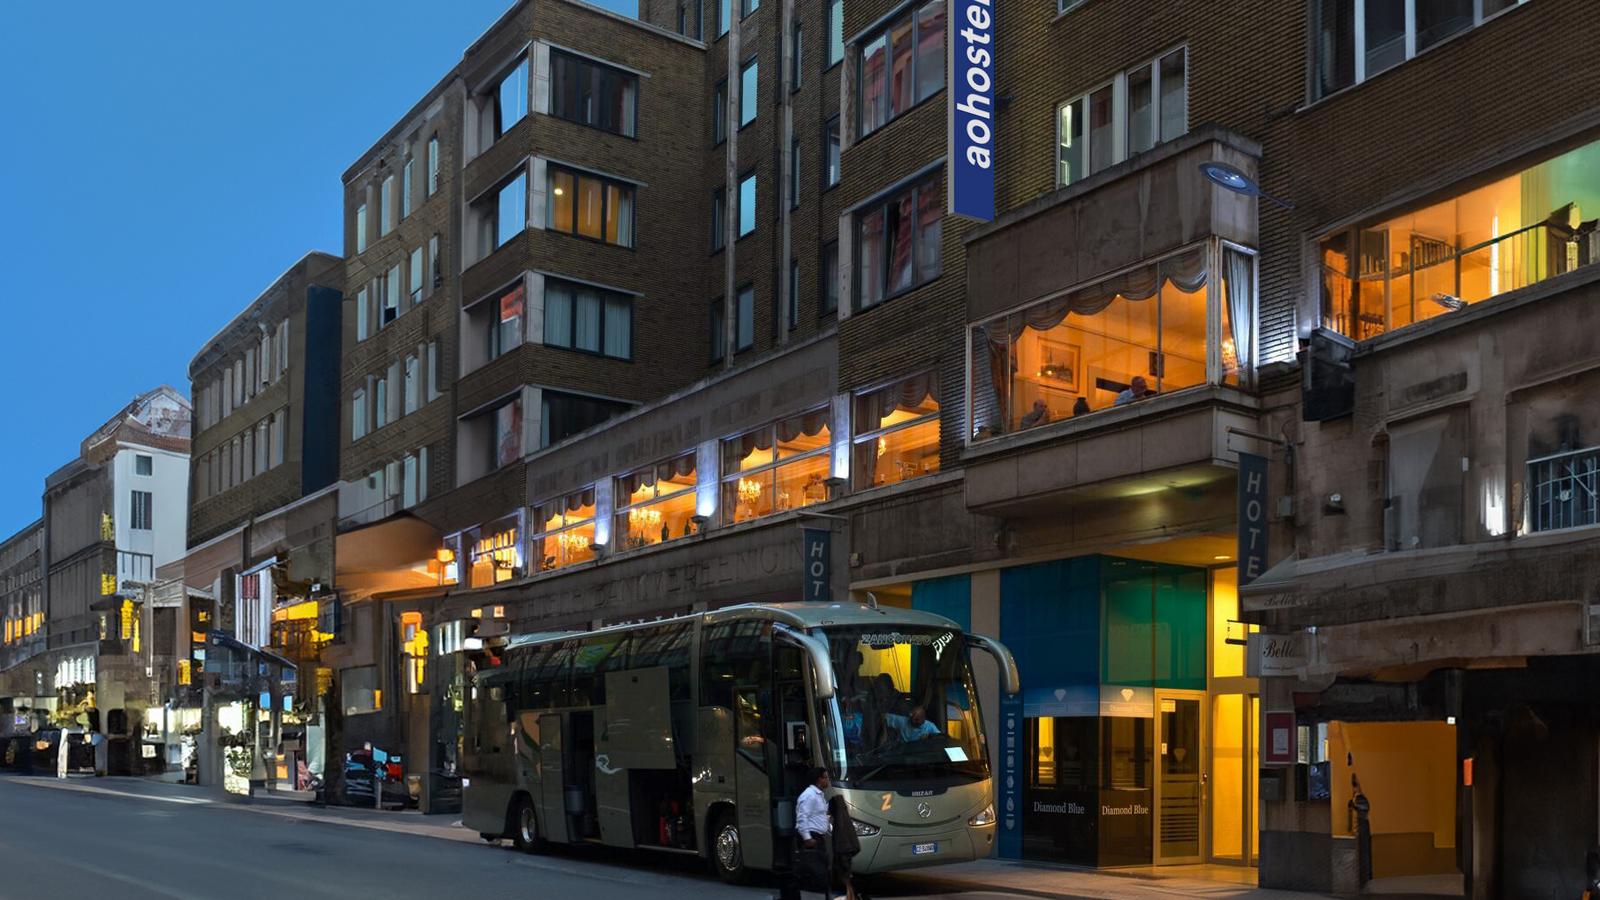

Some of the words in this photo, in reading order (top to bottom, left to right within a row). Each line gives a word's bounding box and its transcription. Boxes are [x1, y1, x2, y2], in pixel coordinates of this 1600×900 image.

[957, 0, 991, 169] aohoste
[810, 541, 825, 597] HOT
[1033, 801, 1067, 814] Diamond
[1068, 802, 1085, 814] Blue
[1102, 805, 1133, 815] Diamond
[1134, 804, 1149, 814] Blue
